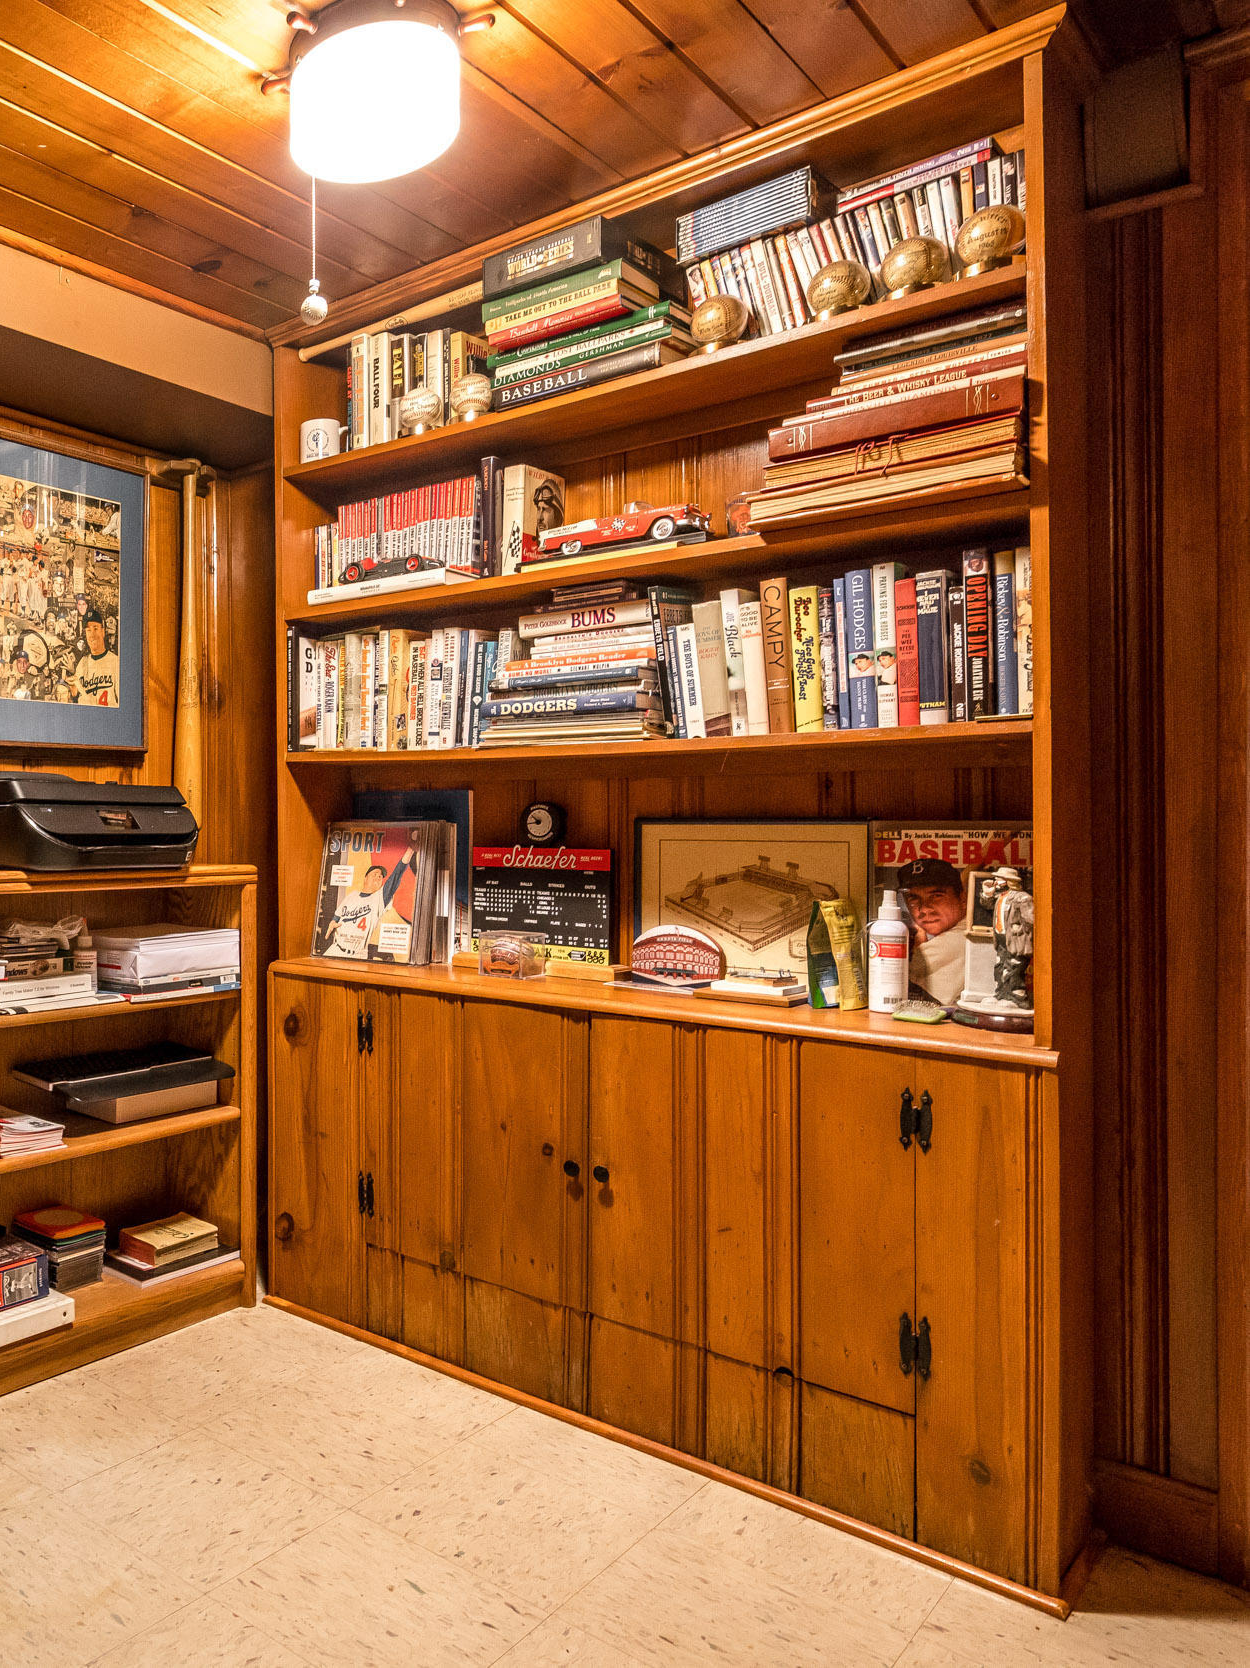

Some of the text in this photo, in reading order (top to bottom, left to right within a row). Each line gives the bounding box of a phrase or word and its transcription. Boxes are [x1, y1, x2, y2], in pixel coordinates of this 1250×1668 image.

[507, 240, 574, 275] WORLD SERIES
[505, 281, 611, 323] TAKE ME OUT TO THE BALL PARK
[509, 313, 574, 339] Baseball Memories
[576, 331, 626, 351] BALLPARKS
[494, 359, 561, 387] DIAMONDS
[579, 340, 624, 359] GERSHMAN
[934, 346, 977, 361] LOUISVILLE
[501, 368, 588, 402] BASEBALL
[843, 369, 967, 406] THE BEER & WHISKY LEAGUE
[852, 575, 863, 599] GIL
[879, 576, 887, 598] PRAYING
[997, 576, 1009, 608] Rickey
[524, 620, 538, 630] PETER
[571, 607, 616, 628] BUMS
[802, 597, 812, 616] Leo
[918, 607, 938, 615] MADE
[654, 619, 662, 643] EBBETS
[763, 585, 785, 669] CAMPY
[794, 597, 806, 642] Durocher
[853, 601, 866, 650] HODGES
[880, 620, 888, 641] HODGES
[725, 612, 742, 659] JOE Black
[804, 636, 813, 657] Nice
[967, 577, 988, 701] OPENING DAY JONATHAN EIG
[998, 619, 1009, 662] Robinson
[531, 657, 564, 668] Brooklyn
[566, 655, 597, 665] Dodgers
[599, 653, 626, 662] Reader
[954, 623, 963, 684] JACKIE ROBINSON
[79, 674, 113, 695] Dodgers
[325, 646, 336, 713] The Era ROGER KAHN
[683, 639, 697, 707] THE BOYS OF SUMMER
[795, 650, 807, 701] Finish Last
[99, 690, 108, 706] 4
[360, 649, 371, 731] Home Run Heard World
[501, 698, 577, 715] DODGERS
[330, 831, 385, 853] SPORT
[875, 831, 900, 839] DELL
[993, 831, 1006, 839] WE
[503, 845, 576, 869] Schaefer
[912, 861, 924, 875] B
[342, 905, 371, 923] Dodgers
[357, 917, 367, 931] 4
